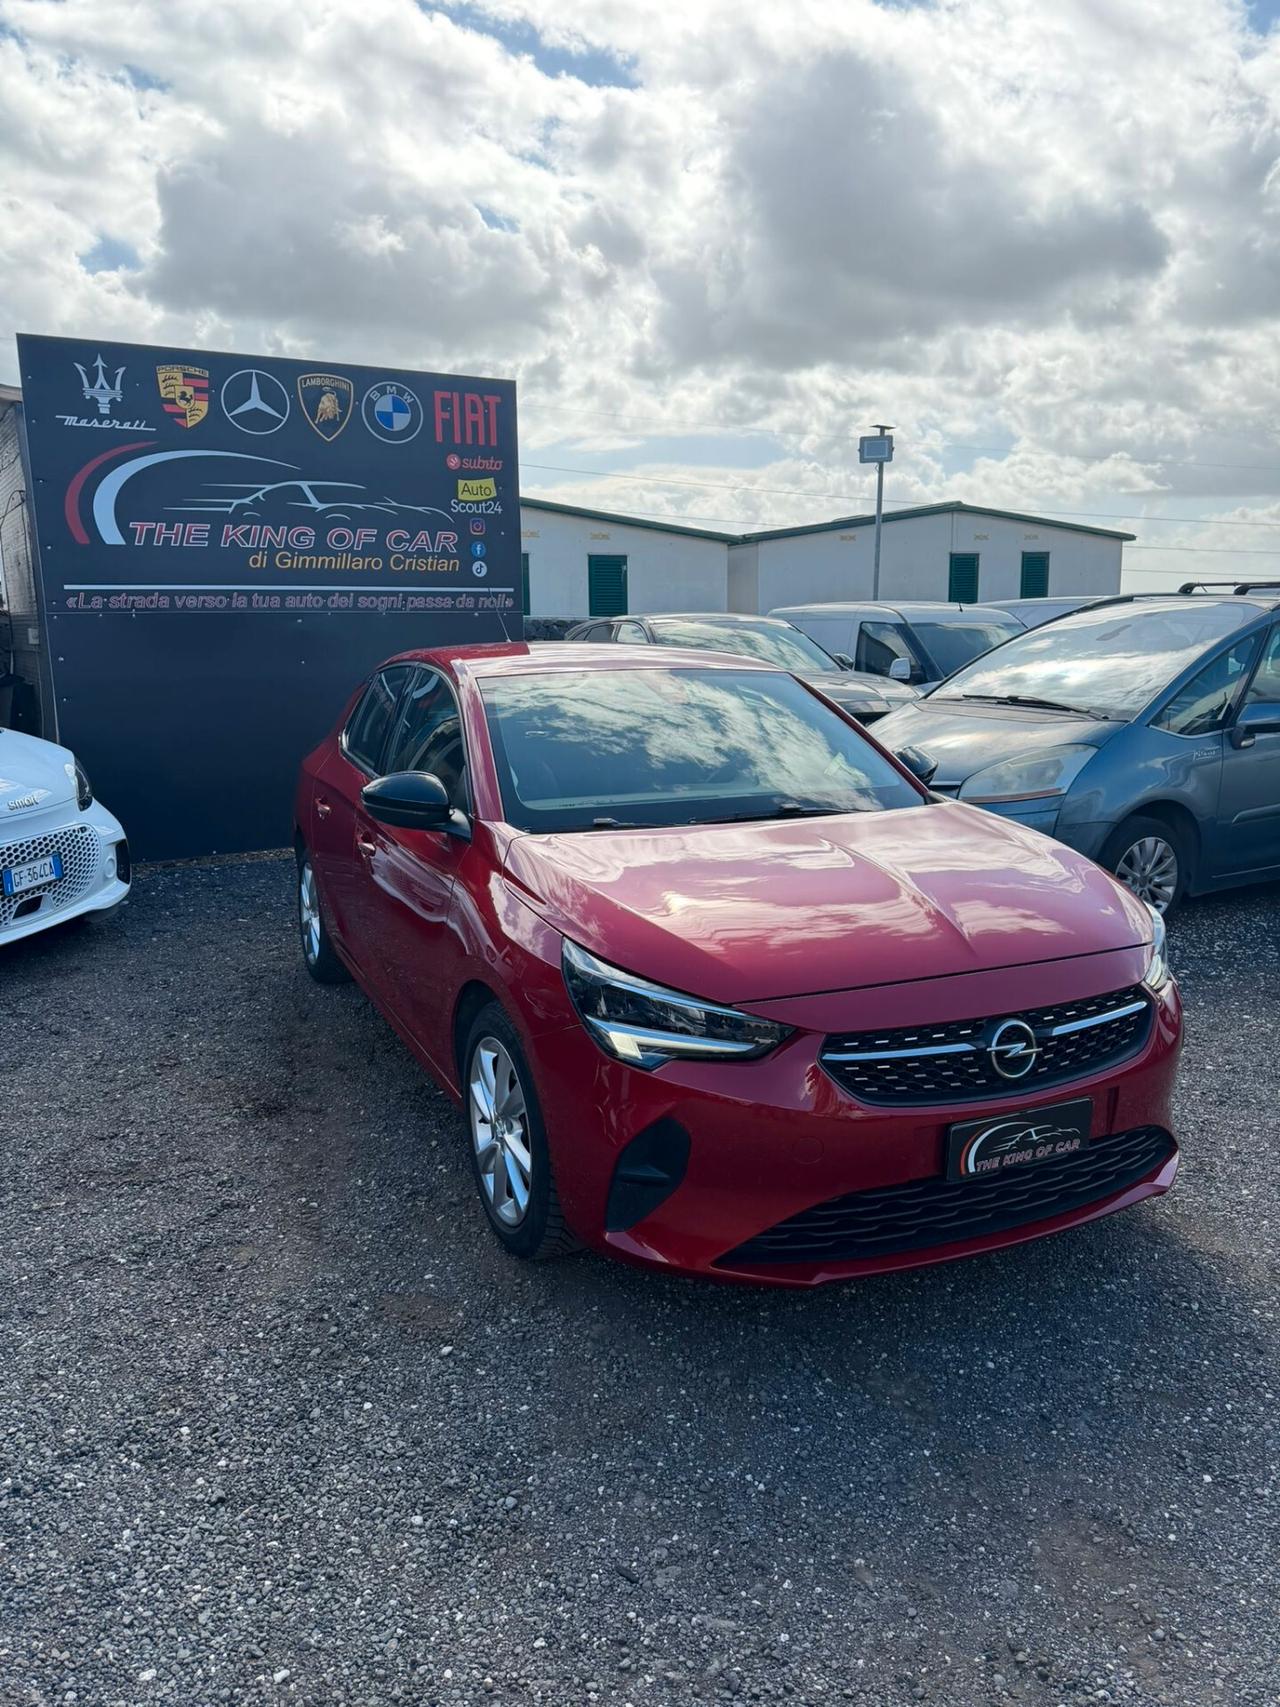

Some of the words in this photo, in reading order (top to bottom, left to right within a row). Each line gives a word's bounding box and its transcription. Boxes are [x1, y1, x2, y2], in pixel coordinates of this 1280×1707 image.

[157, 365, 208, 376] PORSCHE
[301, 376, 350, 392] LAMBORGHINI
[370, 385, 414, 404] BMW
[434, 390, 502, 446] FIAT
[462, 456, 503, 470] subito
[461, 482, 492, 497] Auto
[450, 499, 503, 514] Scout24
[129, 521, 211, 546] THE
[220, 523, 316, 550] KING
[326, 527, 377, 551] OF
[386, 529, 459, 553] CAR
[249, 551, 267, 568] di
[275, 551, 383, 571] Gimmillaro
[390, 553, 460, 572] Cristian
[108, 592, 170, 609] strada
[174, 595, 227, 609] verso
[231, 591, 248, 608] la
[252, 592, 281, 608] tua
[284, 593, 323, 608] auto
[327, 592, 354, 608] dei
[357, 593, 403, 612] sogni
[406, 596, 453, 613] passa
[456, 593, 474, 609] da
[8, 795, 39, 811] smart
[976, 1157, 1000, 1172] THE
[1003, 1149, 1033, 1166] KING
[1036, 1144, 1053, 1158] OF
[1055, 1138, 1080, 1153] CAR
